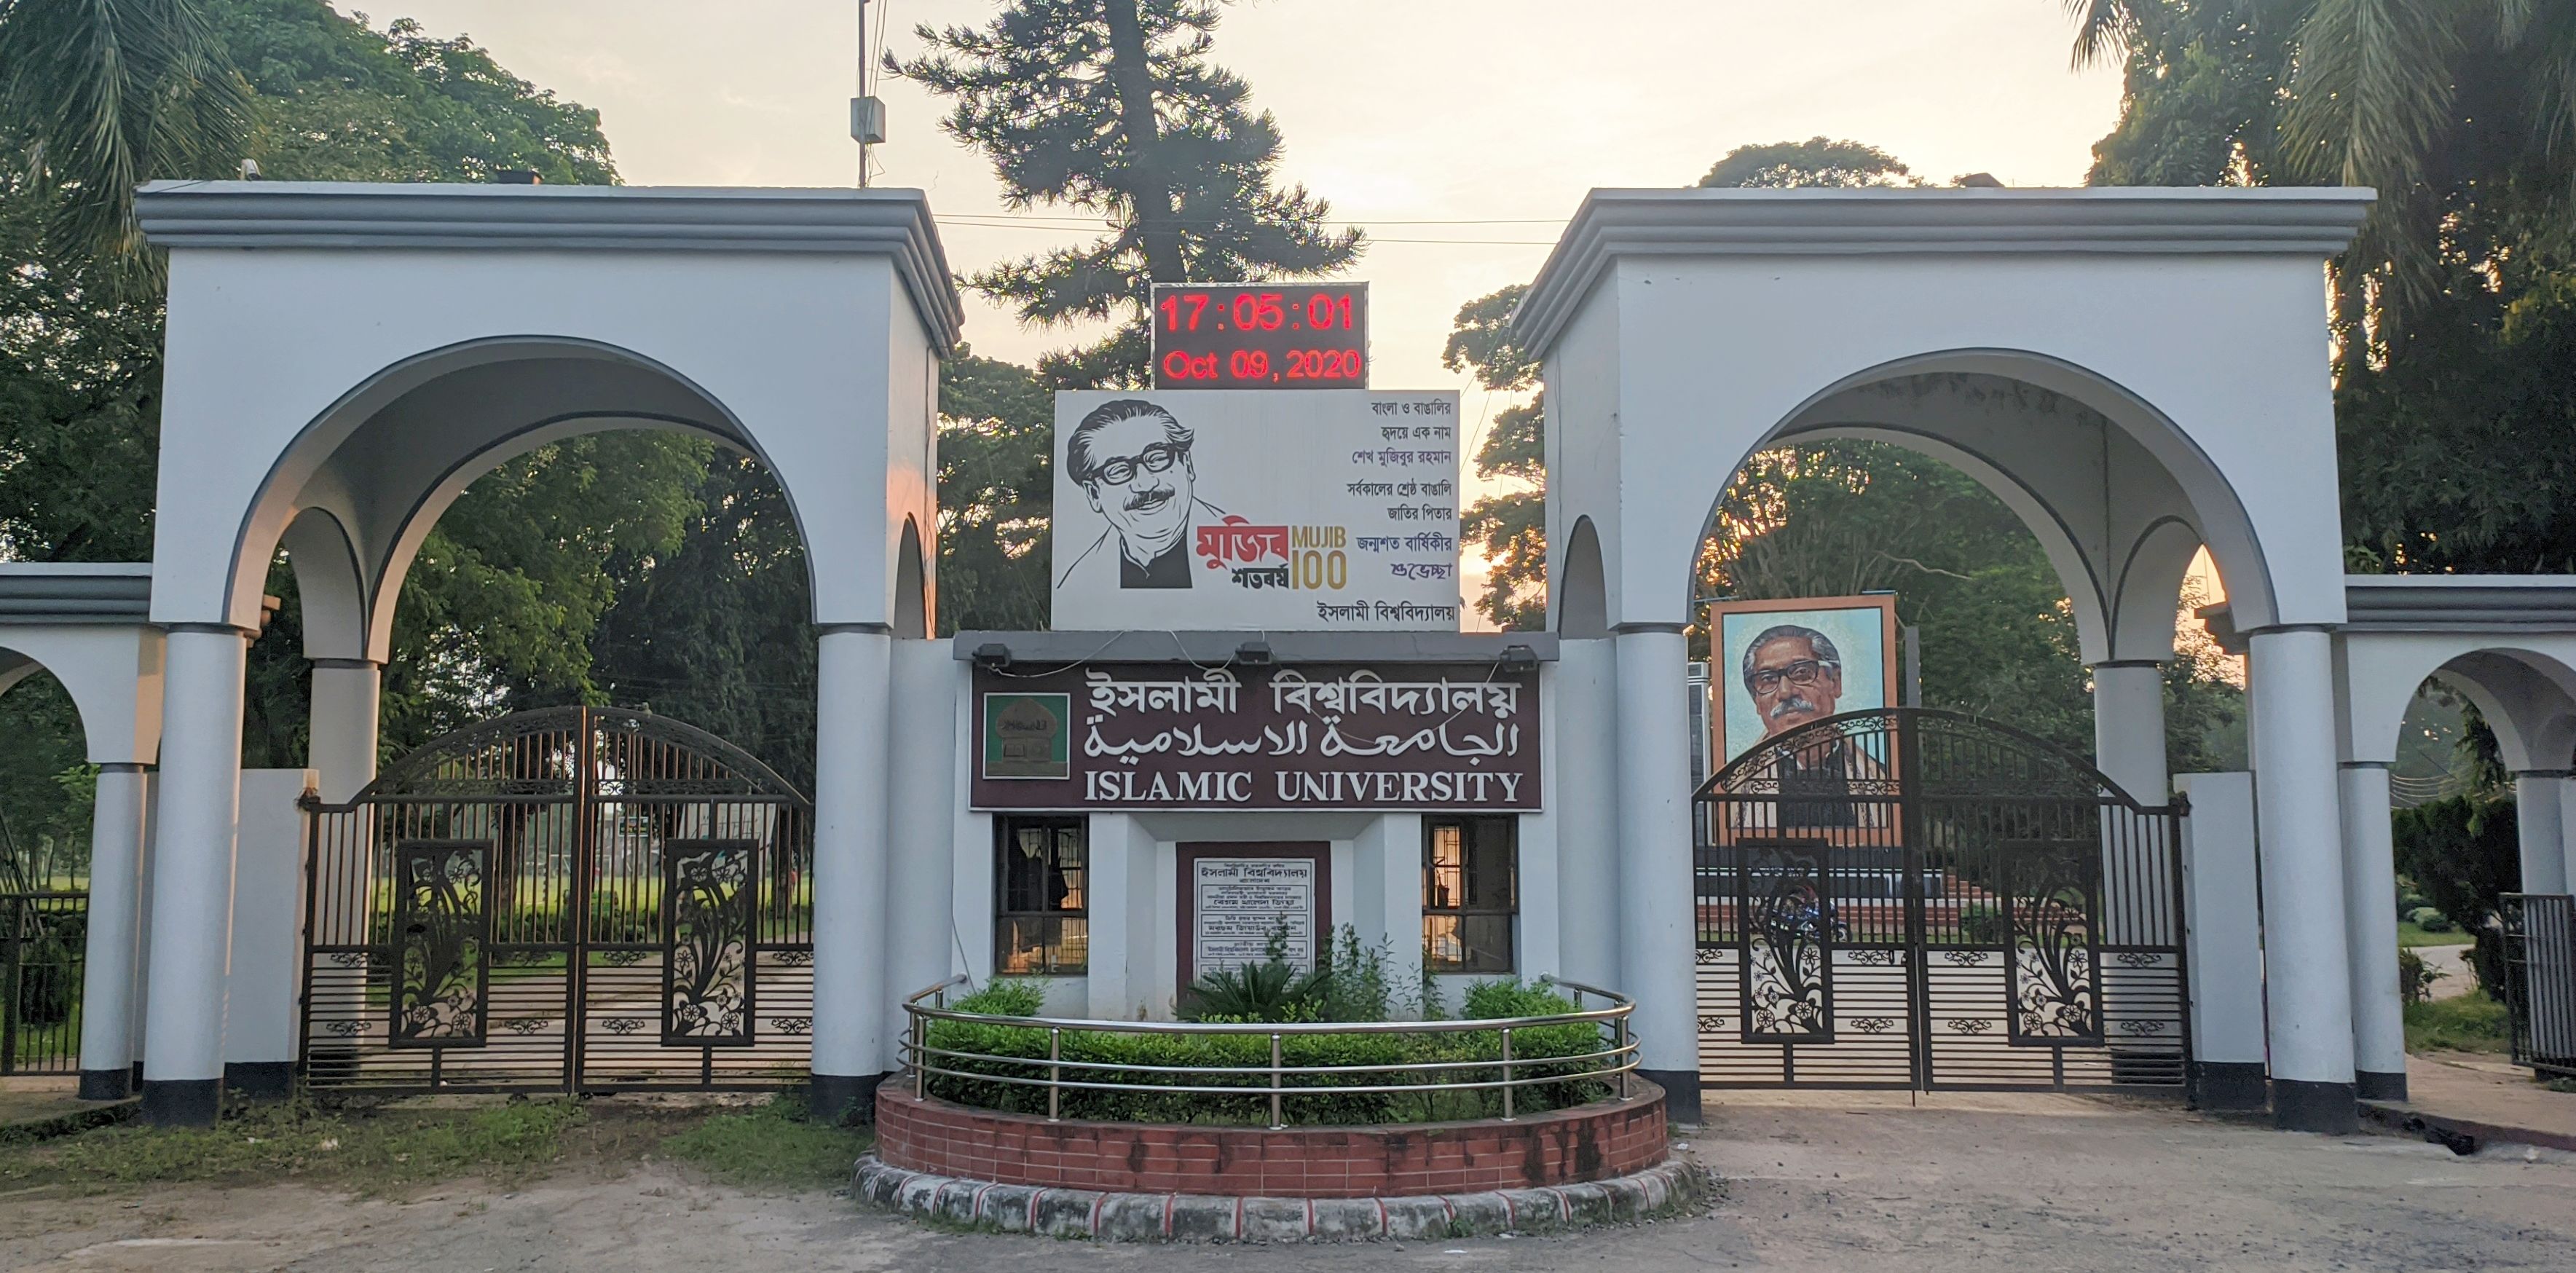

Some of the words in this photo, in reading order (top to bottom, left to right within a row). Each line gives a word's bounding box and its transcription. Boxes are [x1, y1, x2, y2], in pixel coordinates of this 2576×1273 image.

[1161, 293, 1352, 331] 17:05:01
[1163, 350, 1218, 379] Oct
[1371, 401, 1398, 416] বাংলা
[1401, 402, 1411, 414] ও
[1413, 398, 1452, 416] বাঙালির
[1381, 426, 1409, 441] হৃদয়ে
[1412, 426, 1430, 439] এক
[1433, 425, 1451, 440] নাম
[1352, 449, 1374, 465] শেখ
[1377, 446, 1414, 467] মুজিবুর
[1417, 449, 1452, 465] রহমান
[1347, 478, 1393, 497] সর্বকালের
[1397, 478, 1417, 498] শ্রেষ্ঠ
[1419, 478, 1452, 497] বাঙালি
[1387, 503, 1419, 521] জাতির
[1422, 503, 1453, 521] পিতার
[1196, 515, 1289, 571] মুজিব
[1291, 525, 1347, 548] MUJIB
[1355, 536, 1401, 553] জন্মশত
[1404, 531, 1452, 554] বার্ষিকীর
[1232, 563, 1289, 589] শতবর্ষ
[1292, 549, 1347, 590] 100
[1390, 562, 1453, 580] শুভেচ্ছা
[1316, 601, 1370, 623] ইসলামী
[1374, 601, 1456, 623] বিশ্ববিদ্যালয়
[1084, 667, 1242, 717] ইসলামী
[1268, 669, 1523, 720] বিশ্ববিদ্যালয়
[1084, 714, 1308, 766] الاسلامية
[1320, 714, 1520, 766] الجامعة
[1084, 770, 1253, 802] ISLAMIC
[1275, 770, 1524, 803] UNIVERSITY
[1201, 867, 1238, 878] ইসলামী
[1243, 867, 1308, 878] বিশ্ববিদ্যালয়
